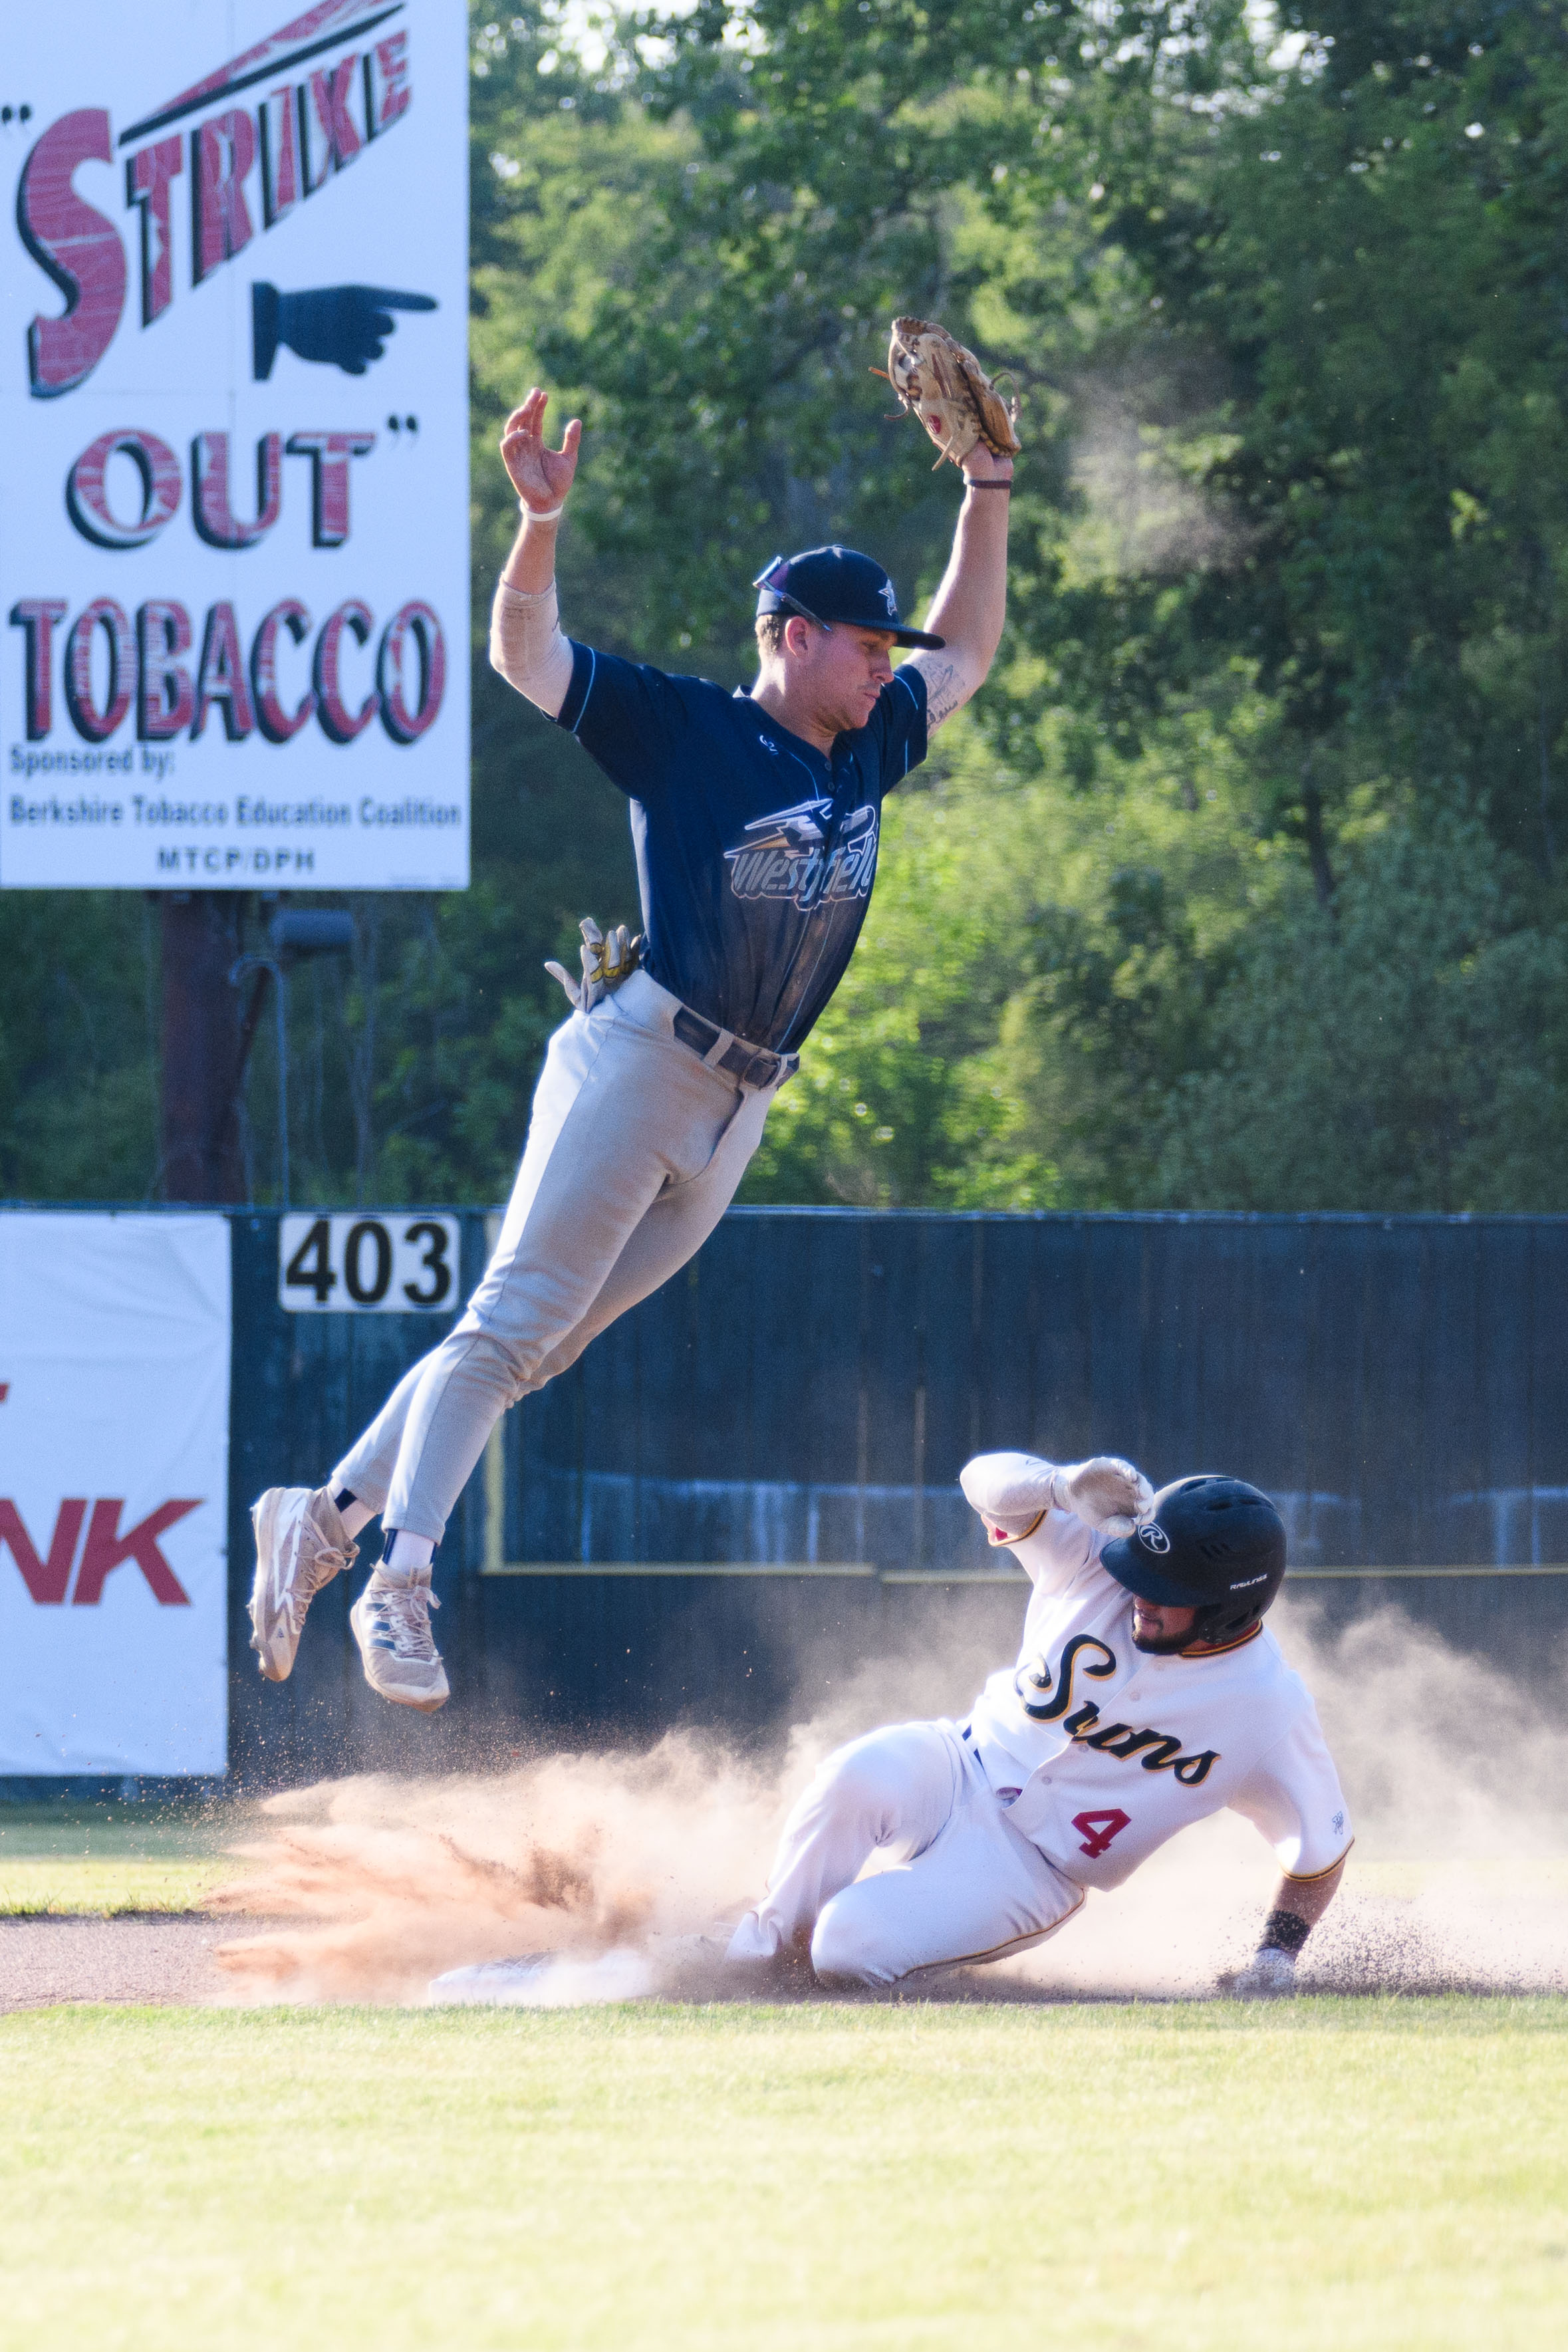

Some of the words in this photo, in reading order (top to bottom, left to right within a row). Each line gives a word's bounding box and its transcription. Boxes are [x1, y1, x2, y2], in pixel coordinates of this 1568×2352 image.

[9, 597, 447, 745] TOBACCO
[9, 744, 133, 780] Sponsored
[9, 795, 124, 825] Berkshire
[132, 795, 229, 826] Tobacco
[236, 795, 352, 827] Education
[358, 797, 461, 827] Coalition
[287, 1221, 450, 1303] 403
[1230, 1573, 1267, 1590] RAWLINGS
[1013, 1633, 1222, 1787] Suns
[1071, 1808, 1132, 1859] 4
